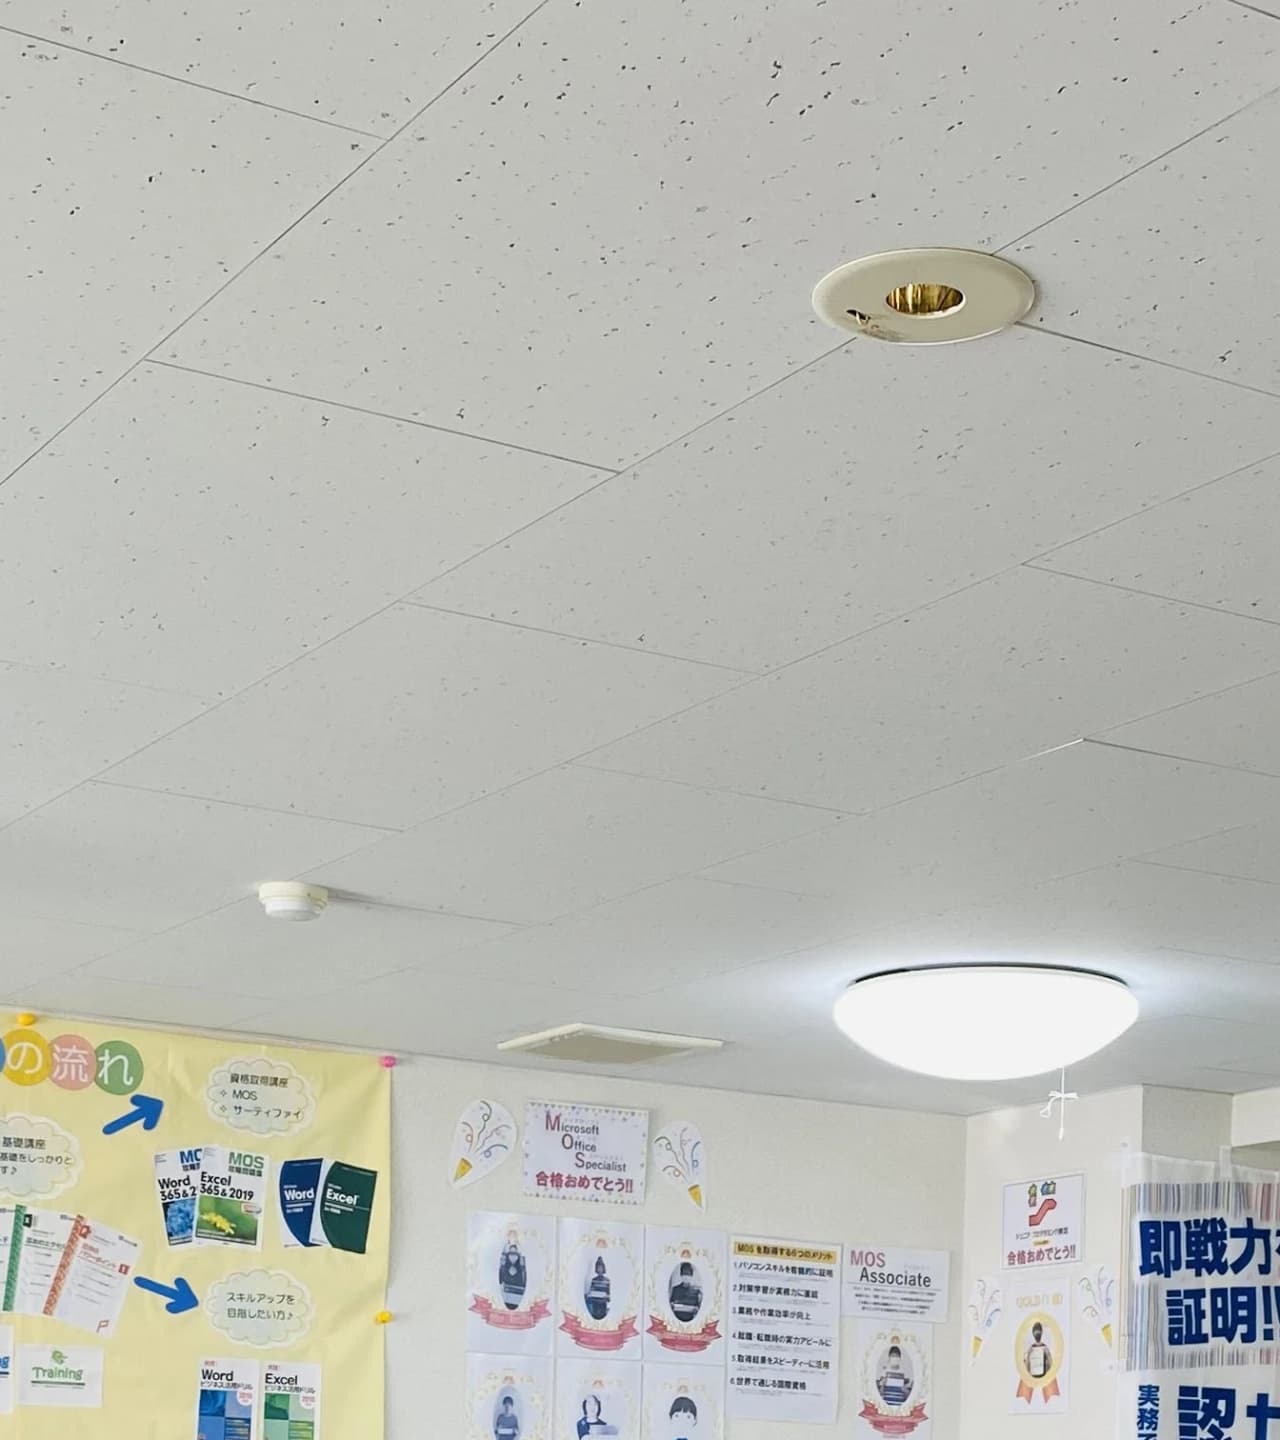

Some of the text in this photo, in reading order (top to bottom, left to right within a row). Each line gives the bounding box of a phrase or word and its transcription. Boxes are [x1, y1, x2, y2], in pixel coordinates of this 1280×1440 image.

[230, 1073, 288, 1088] 資格取得講座
[232, 1090, 257, 1101] MOS
[234, 1105, 302, 1119] サーティファイ
[545, 1111, 600, 1135] Microsoft
[2, 1136, 46, 1150] 基礎講座
[561, 1134, 596, 1152] Office
[179, 1149, 202, 1164] MO
[228, 1152, 265, 1170] MOS
[575, 1151, 626, 1172] Specialist
[158, 1175, 190, 1190] Word
[200, 1171, 231, 1186] Excel
[536, 1171, 634, 1193] 合格おめでとう!!
[160, 1187, 197, 1201] 365&2
[283, 1188, 314, 1201] Word
[326, 1189, 358, 1205] Excel
[850, 1250, 886, 1268] MOS
[1008, 1244, 1076, 1265] 合格おめでとう!!
[860, 1268, 932, 1288] Associate
[227, 1291, 295, 1306] スキルアップを
[32, 1366, 83, 1381] Training
[201, 1369, 234, 1382] Word
[265, 1373, 298, 1386] Excel
